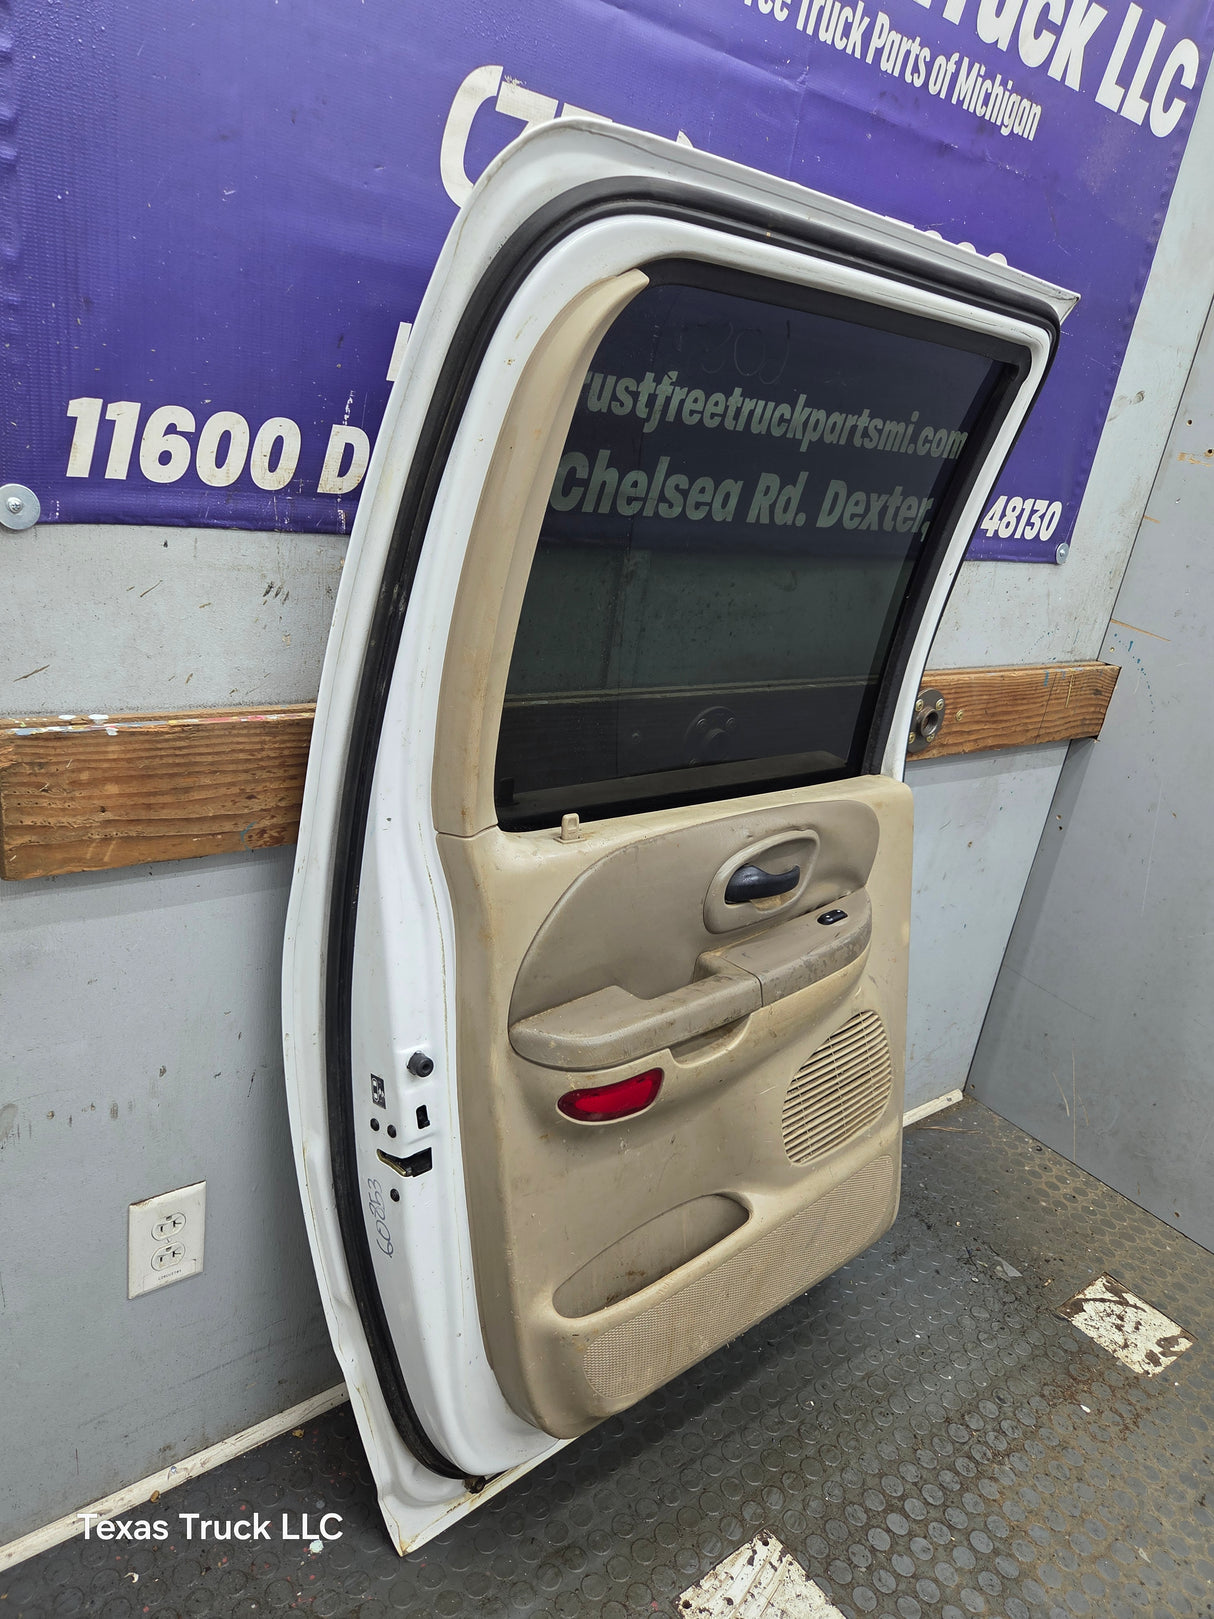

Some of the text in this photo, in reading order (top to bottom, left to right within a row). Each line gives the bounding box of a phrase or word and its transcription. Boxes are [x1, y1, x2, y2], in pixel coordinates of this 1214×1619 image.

[865, 11, 930, 88] Parts
[927, 52, 960, 99] of
[951, 56, 1042, 141] Michigan
[912, 0, 1199, 138] uck LLC
[65, 397, 301, 490] 11600
[583, 370, 968, 461] ustfreetruckpartsmi.com
[550, 449, 1063, 543] Chelsea Rd. Dexter, 48130
